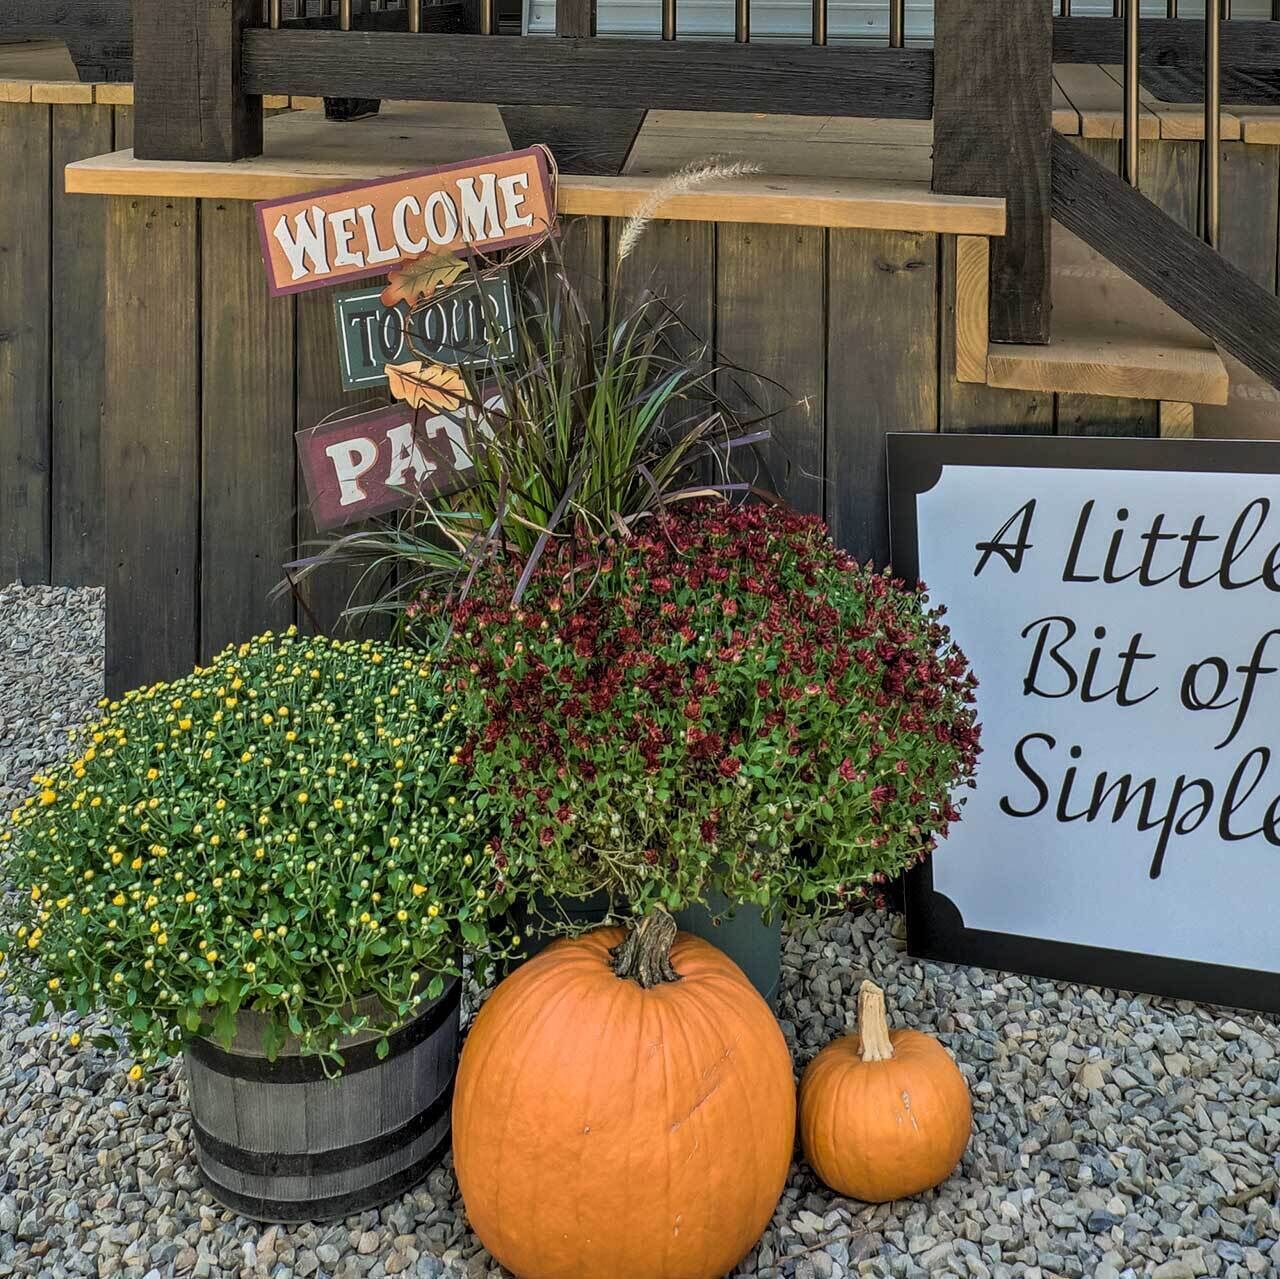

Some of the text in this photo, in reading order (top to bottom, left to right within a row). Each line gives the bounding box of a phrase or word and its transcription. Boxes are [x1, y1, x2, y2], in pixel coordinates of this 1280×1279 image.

[273, 172, 535, 280] WELCOME
[348, 294, 505, 367] TO OUR
[973, 498, 1037, 577] A
[1020, 615, 1159, 708] Bit
